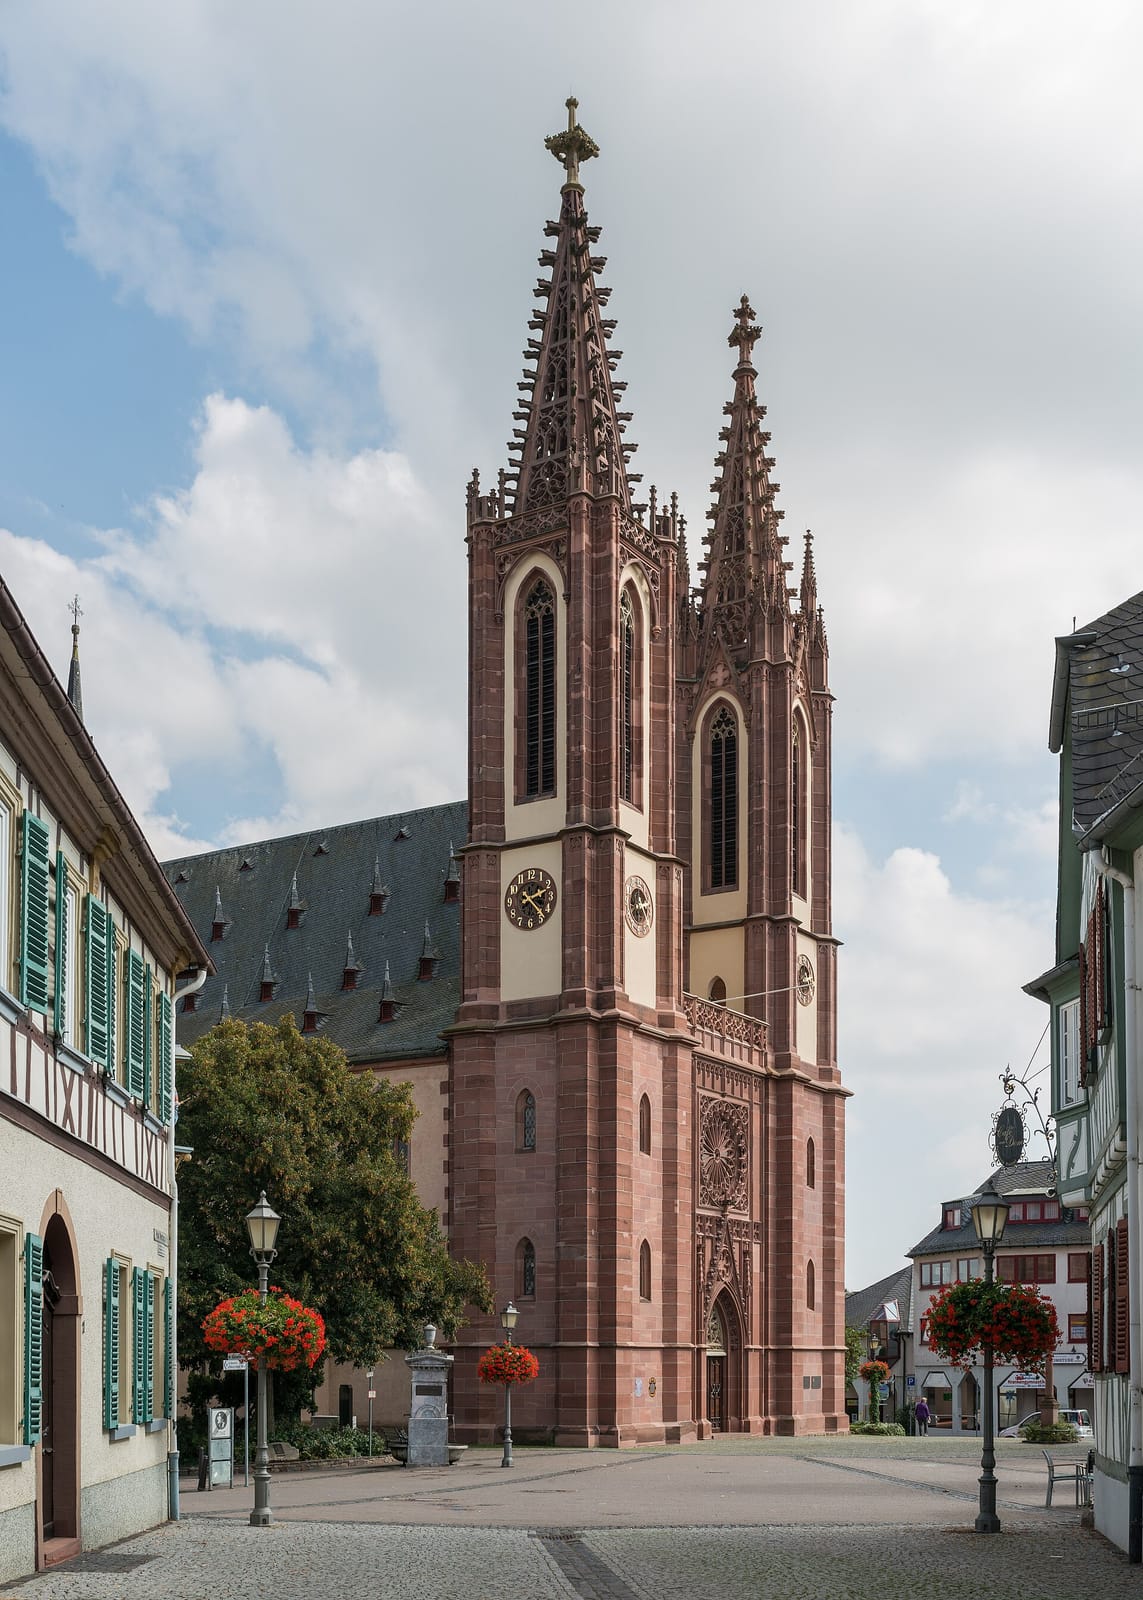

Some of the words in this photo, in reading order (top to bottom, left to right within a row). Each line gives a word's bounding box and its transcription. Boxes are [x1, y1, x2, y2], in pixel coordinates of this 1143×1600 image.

[518, 874, 524, 884] 11
[527, 870, 535, 880] 12
[539, 871, 543, 881] 1
[545, 880, 551, 889] 2
[510, 885, 518, 895] 10
[548, 891, 554, 901] 3
[507, 897, 512, 907] 9
[510, 908, 516, 918] 8
[545, 903, 551, 913] 4
[517, 917, 522, 926] 7
[527, 918, 533, 928] 6
[538, 914, 544, 924] 5
